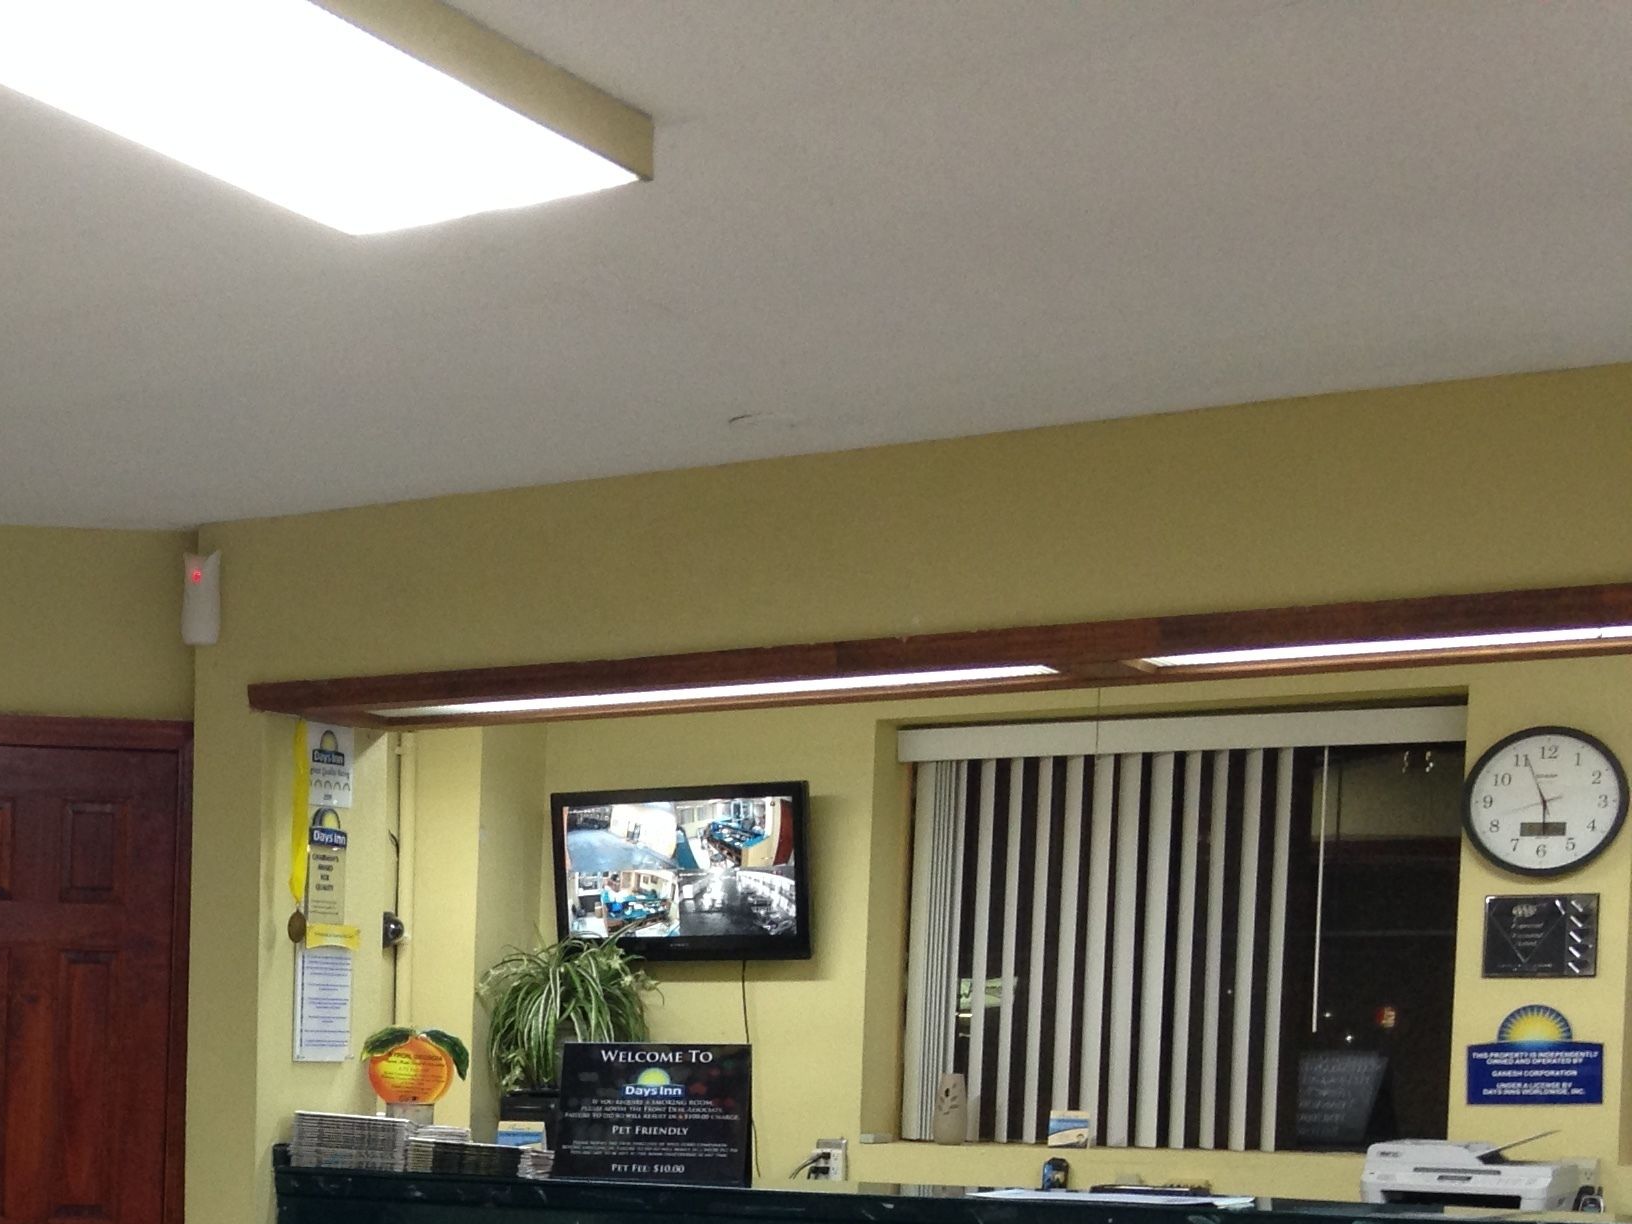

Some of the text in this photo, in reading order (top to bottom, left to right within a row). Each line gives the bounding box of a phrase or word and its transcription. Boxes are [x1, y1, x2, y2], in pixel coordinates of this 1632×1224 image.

[1539, 744, 1559, 760] 12
[1513, 754, 1529, 768] 11
[1575, 752, 1582, 767] 1
[1493, 773, 1512, 787] 10
[1591, 771, 1603, 785] 2
[1482, 795, 1494, 809] 9
[1598, 795, 1609, 809] 3
[1489, 820, 1500, 833] 8
[1586, 818, 1597, 833] 4
[313, 829, 346, 845] Days Inn
[1565, 837, 1576, 851] 5
[1510, 838, 1521, 852] 7
[1536, 844, 1547, 858] 6
[625, 1086, 682, 1097] Days Inn
[611, 1125, 689, 1136] PET FRIENDLY
